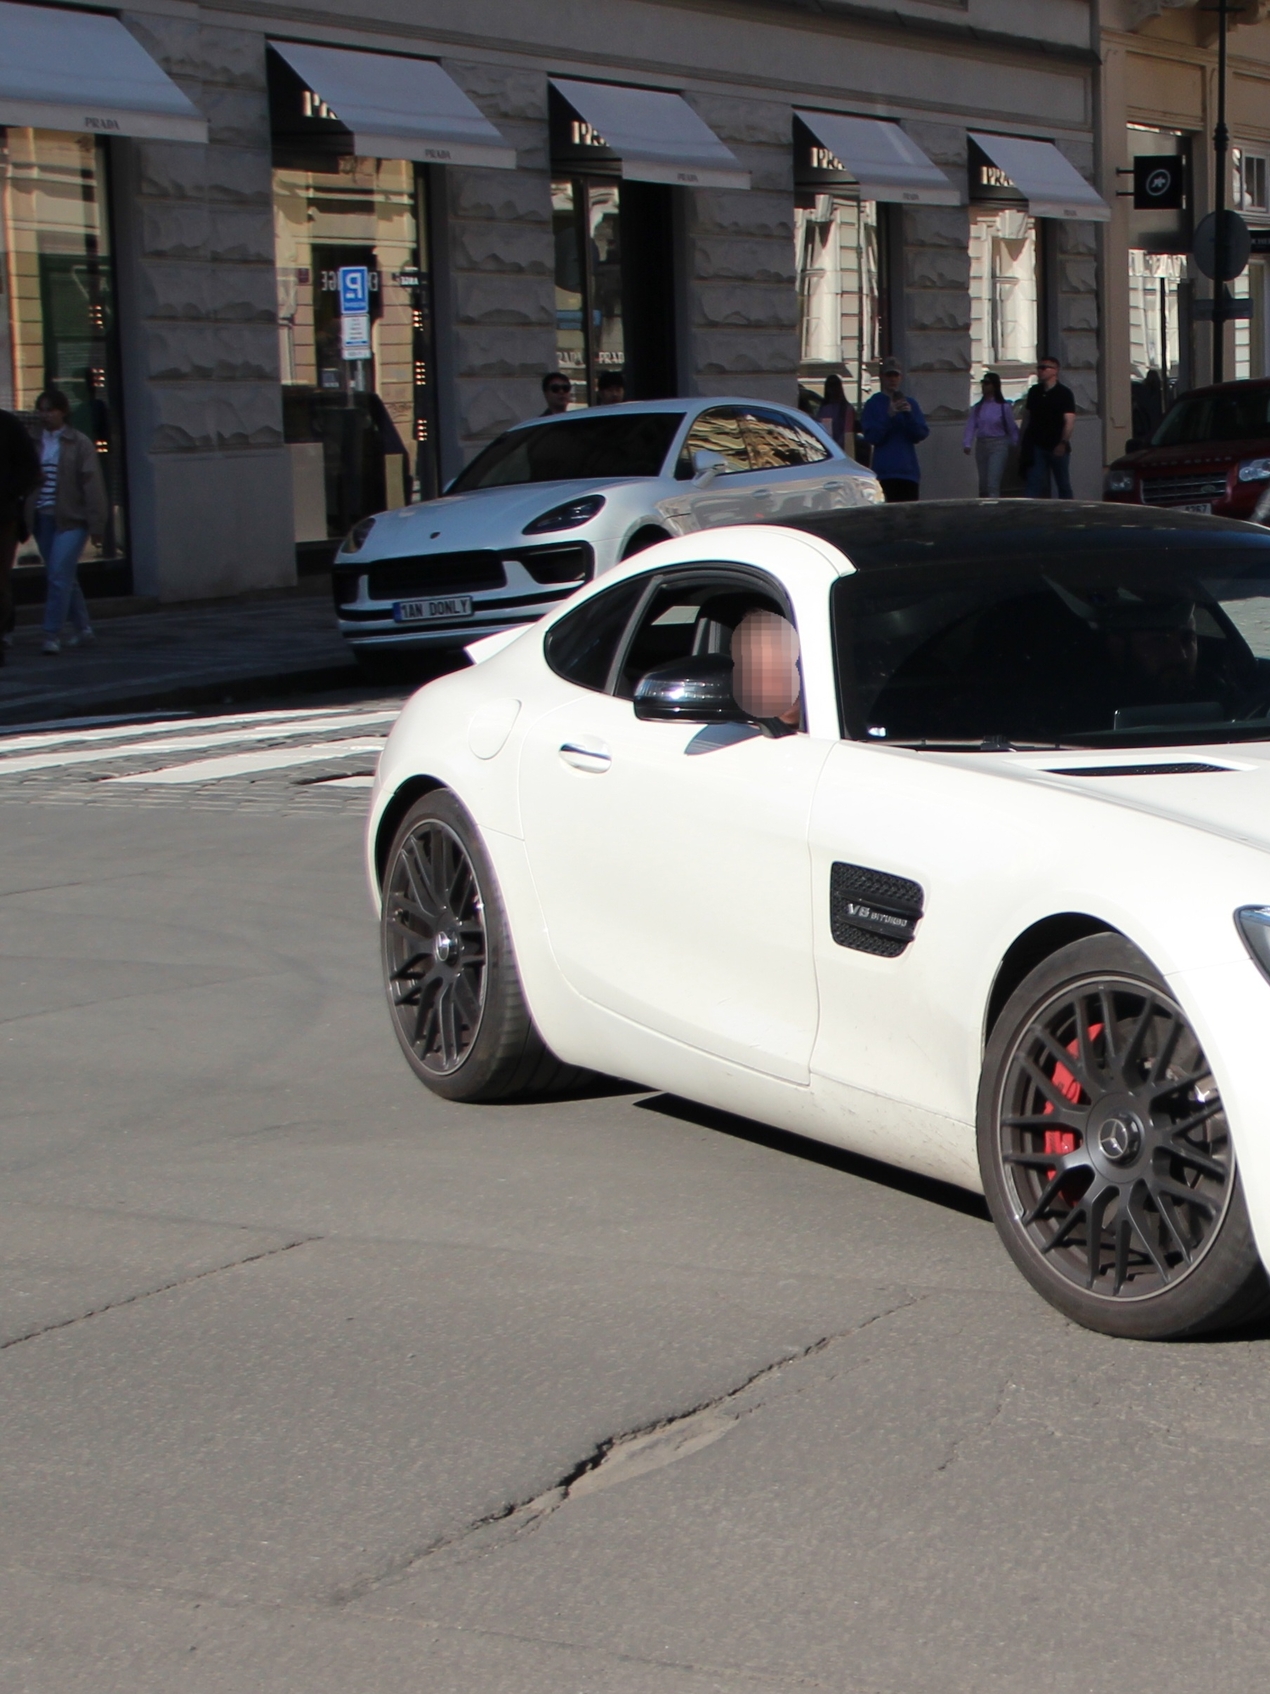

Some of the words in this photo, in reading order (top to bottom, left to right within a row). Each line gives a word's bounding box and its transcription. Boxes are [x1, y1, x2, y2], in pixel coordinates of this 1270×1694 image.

[85, 117, 120, 130] PRADA
[401, 603, 423, 618] 1AN
[429, 600, 470, 616] DONLY
[847, 903, 870, 918] V8
[871, 911, 908, 927] BITURBO
